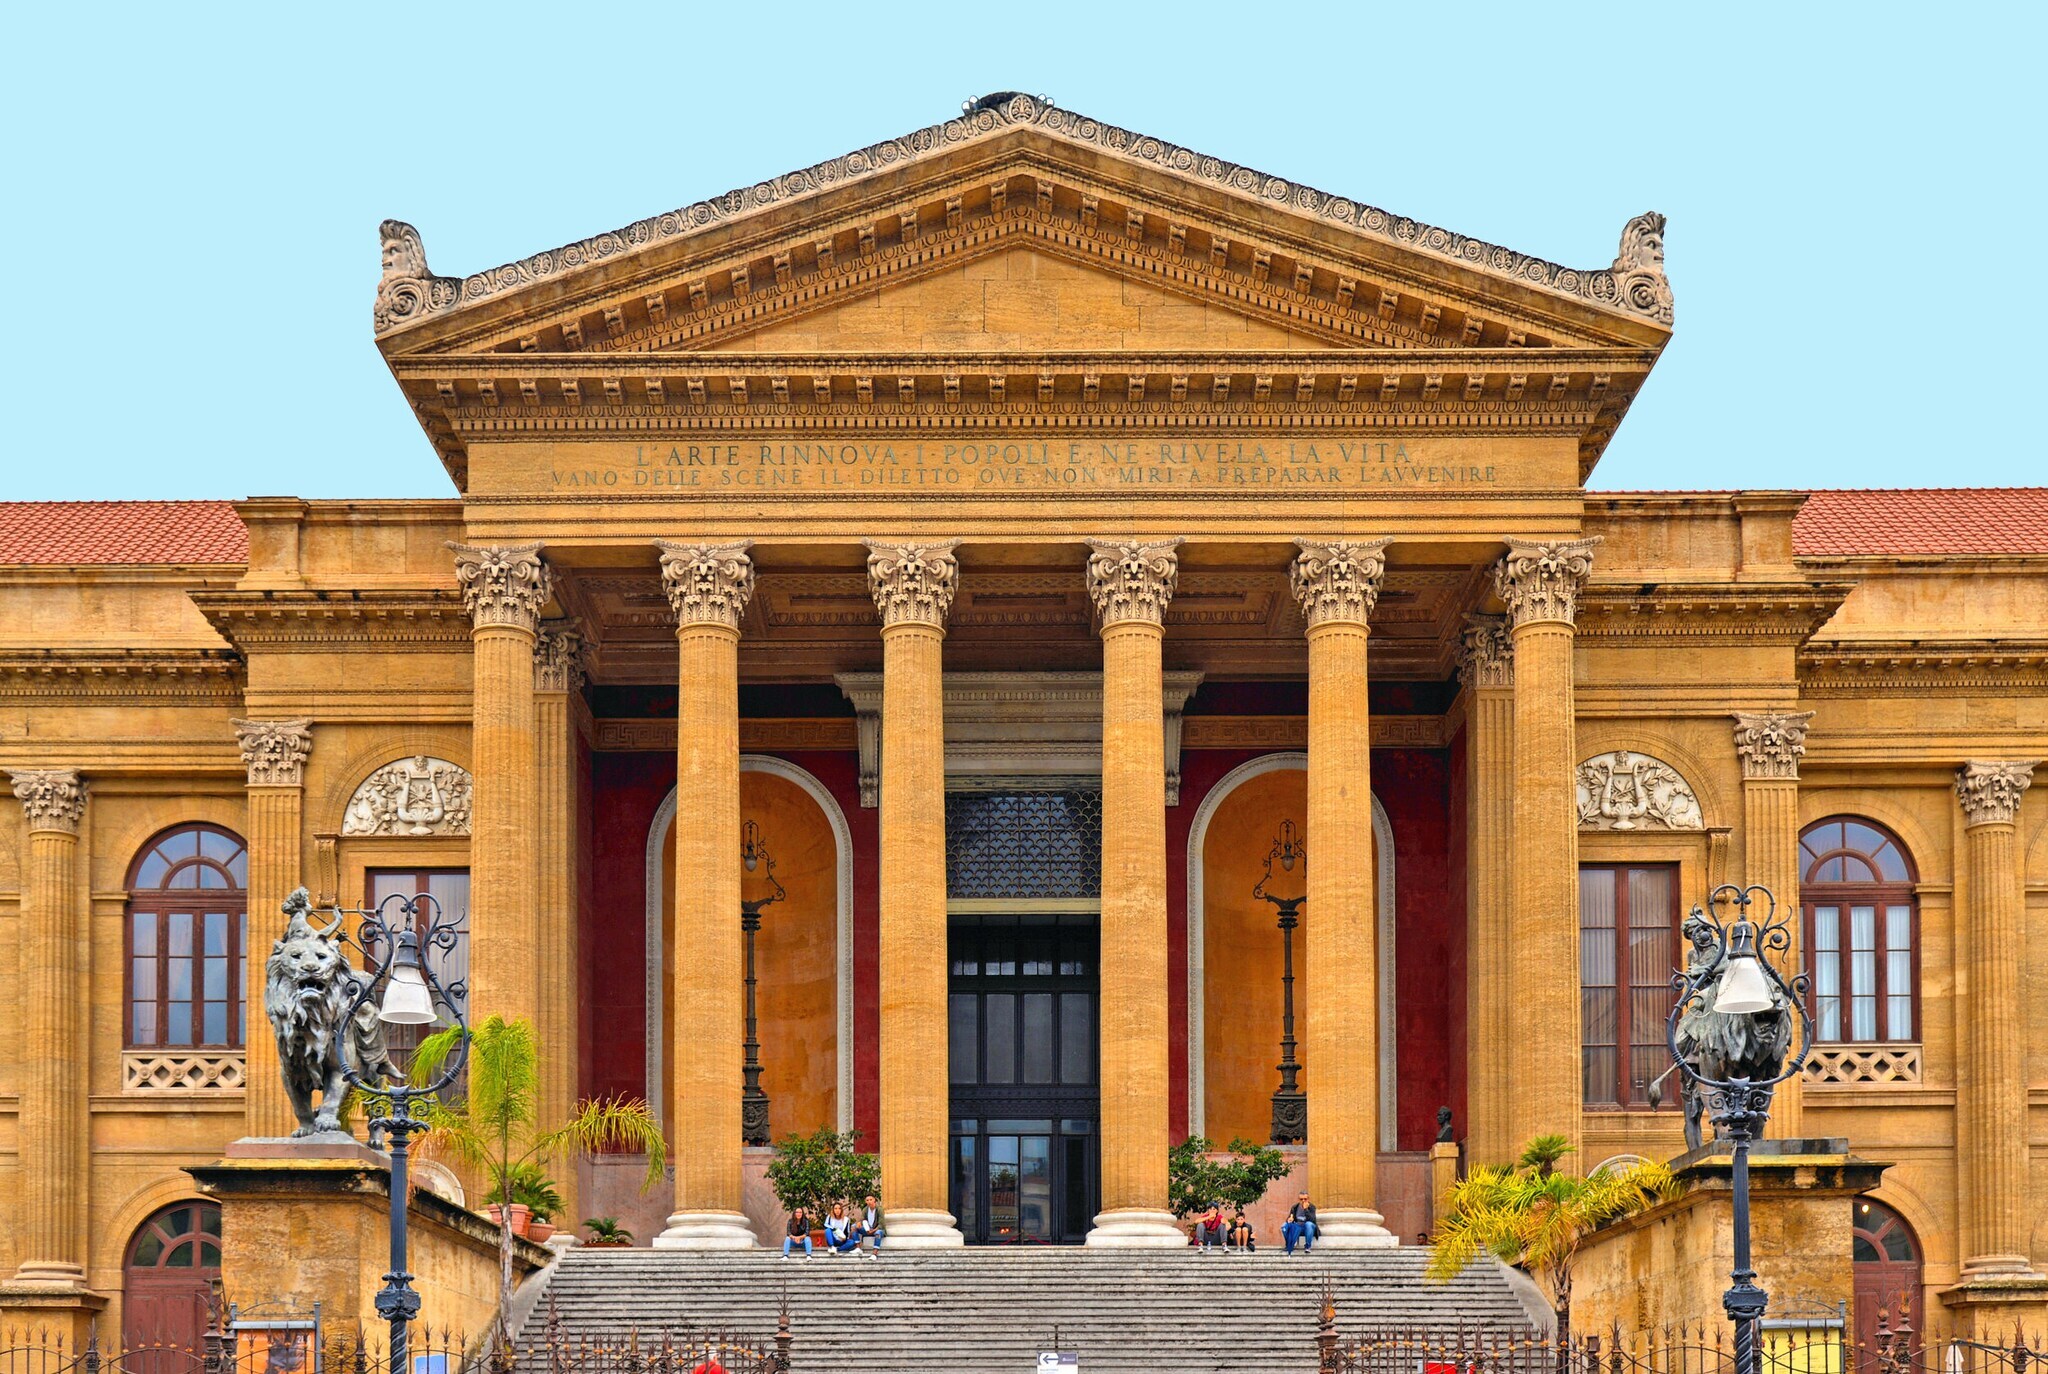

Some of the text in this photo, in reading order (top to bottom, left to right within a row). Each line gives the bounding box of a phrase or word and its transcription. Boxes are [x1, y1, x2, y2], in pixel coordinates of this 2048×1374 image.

[759, 445, 899, 466] RINNOVA
[916, 444, 925, 465] I
[943, 443, 1049, 465] POPOLI
[1068, 444, 1082, 464] E
[1100, 443, 1139, 464] NE
[1159, 443, 1269, 464] RIVELA
[1289, 443, 1322, 464] LA
[1337, 443, 1412, 464] VITA
[552, 470, 618, 486] VANO
[634, 470, 701, 486] DELLE
[721, 469, 802, 485] SCENE
[821, 468, 843, 485] IL
[860, 468, 960, 484] DILETTO
[980, 467, 1025, 484] OVE
[1044, 467, 1097, 483] NON
[1119, 467, 1173, 483] MIRI
[1188, 467, 1201, 482] A
[1217, 466, 1343, 483] PREPARAR
